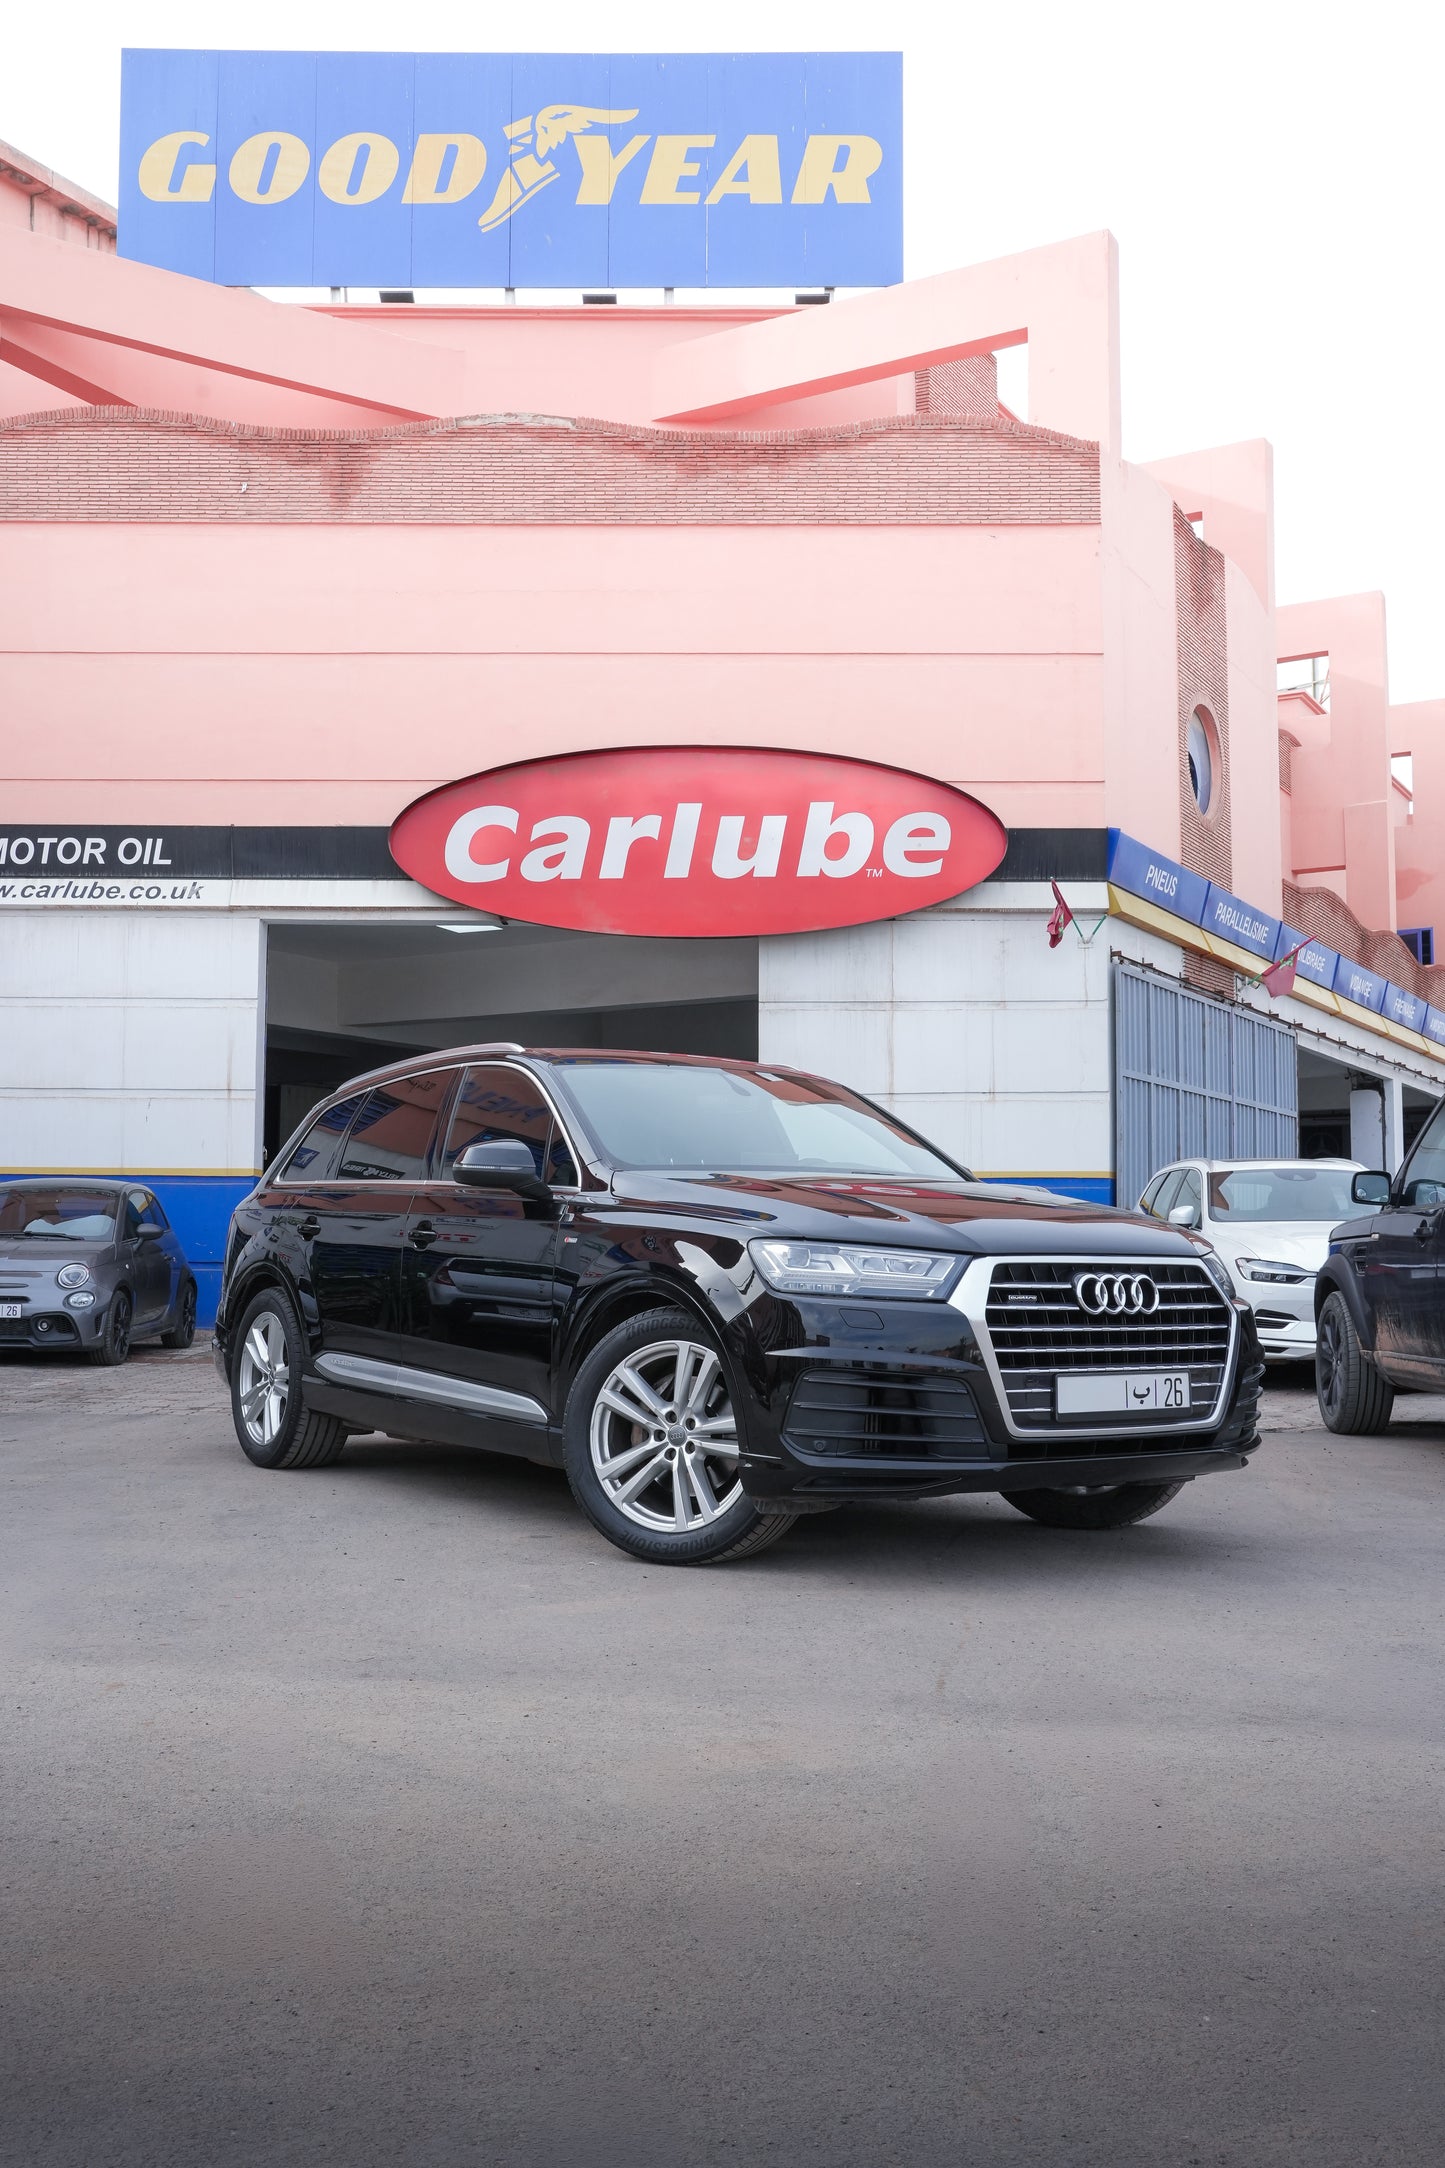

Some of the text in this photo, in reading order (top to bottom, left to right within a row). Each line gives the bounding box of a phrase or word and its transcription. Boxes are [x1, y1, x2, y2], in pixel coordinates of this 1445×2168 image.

[117, 837, 172, 865] OIL
[444, 802, 951, 883] Carlube
[865, 868, 883, 878] TM
[1145, 864, 1178, 896] PNEUS
[1215, 902, 1269, 944] PARALLELISME
[6, 1305, 18, 1317] 26
[1133, 1386, 1150, 1405] ب
[1164, 1378, 1183, 1407] 26
